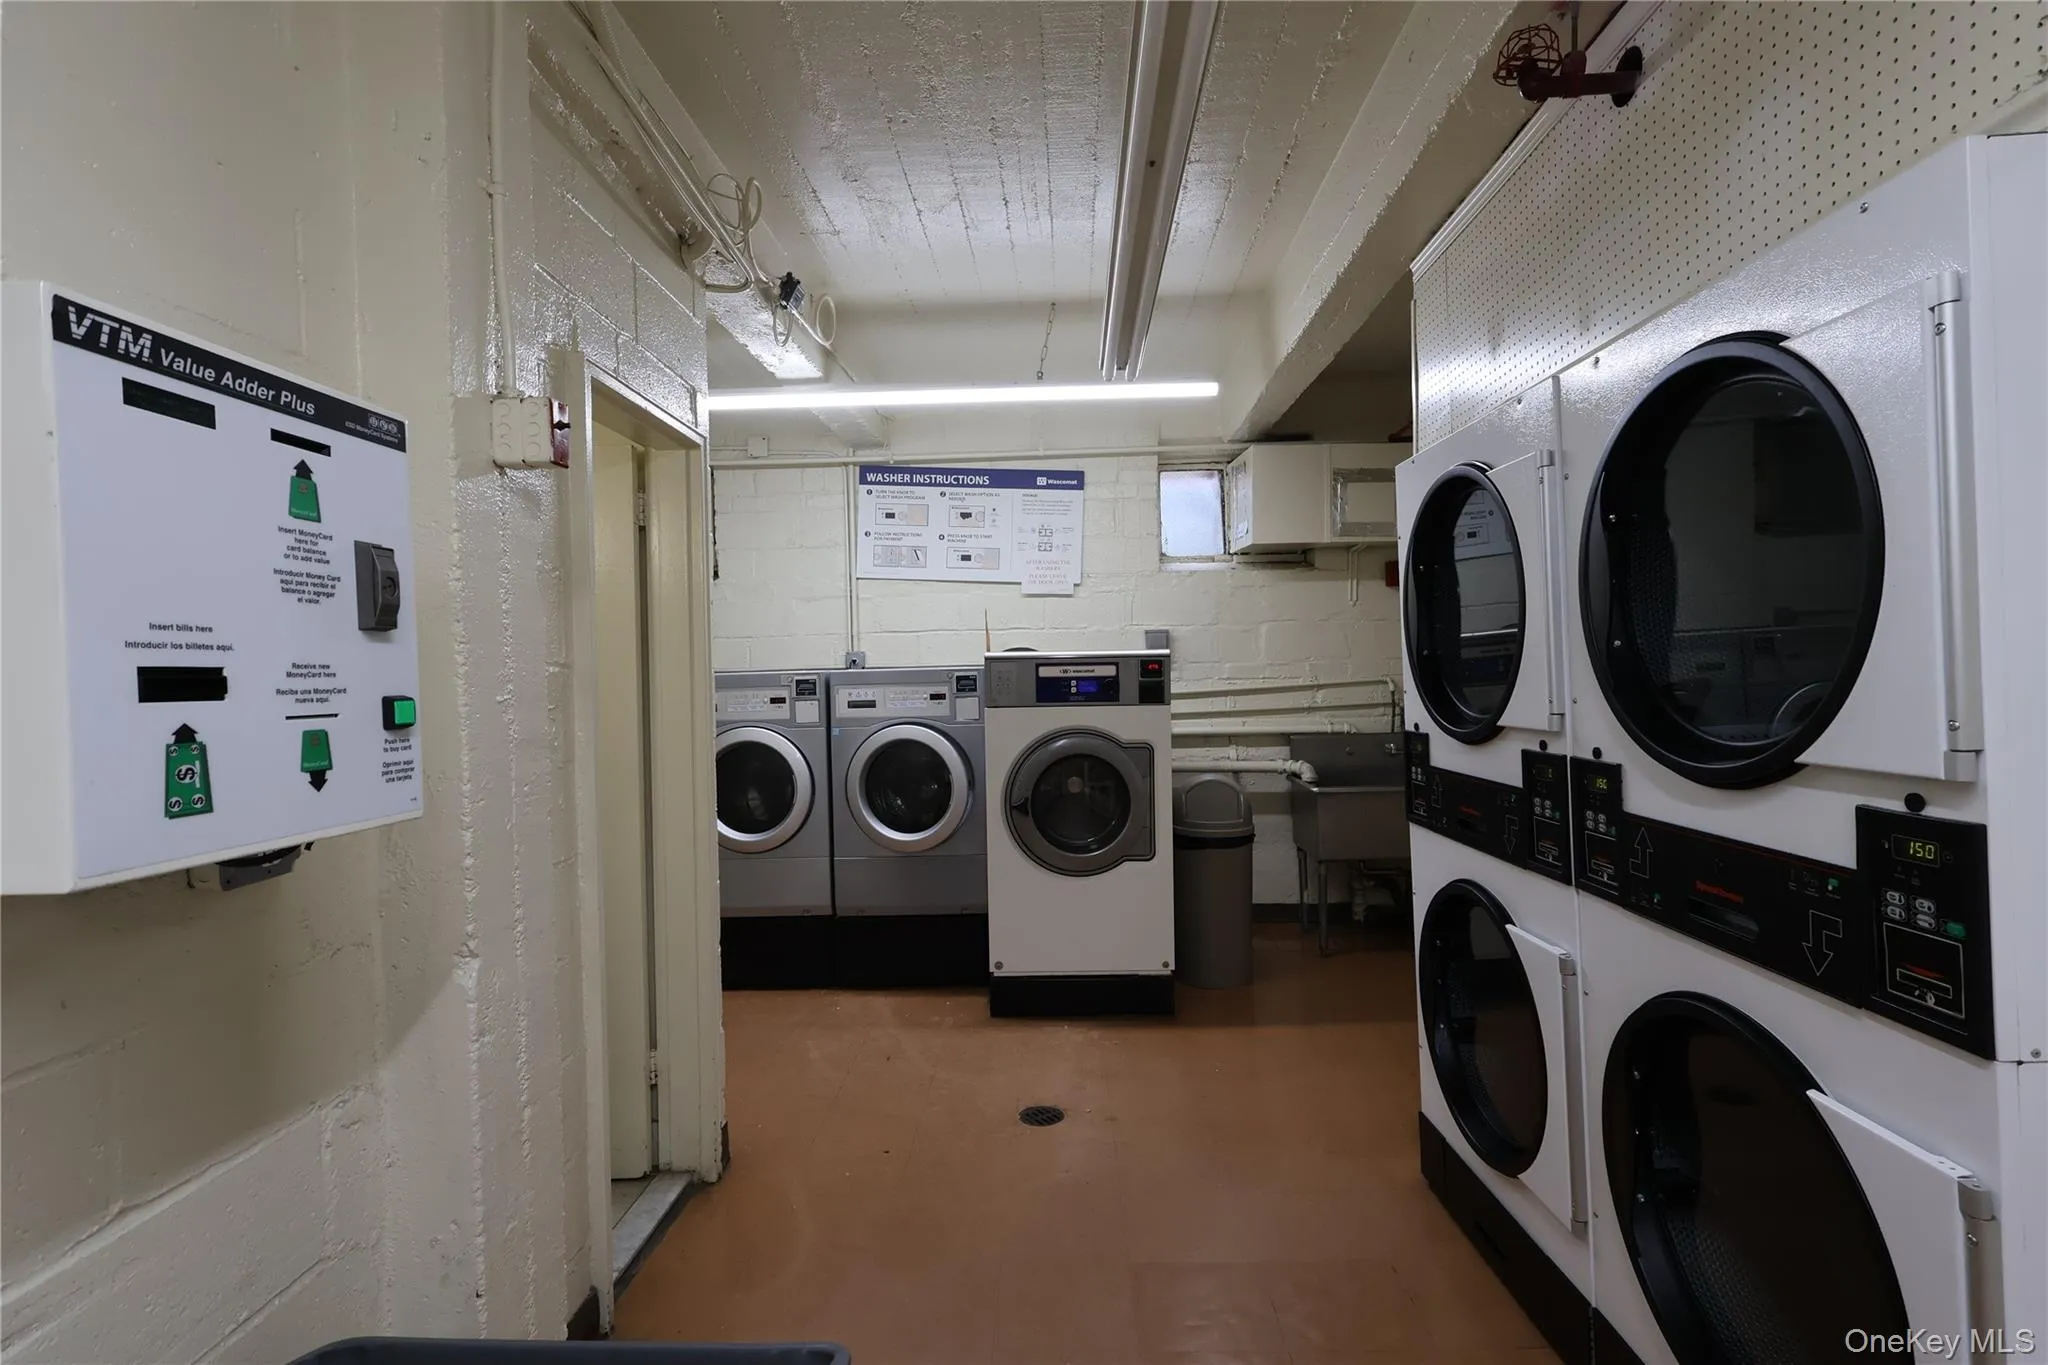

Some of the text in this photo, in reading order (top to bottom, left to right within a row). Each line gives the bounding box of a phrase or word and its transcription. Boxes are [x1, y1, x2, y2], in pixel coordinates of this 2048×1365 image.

[67, 305, 315, 415] VTM Value Adder Plus
[866, 473, 990, 484] WASHER INSTRUCTIONS
[278, 526, 333, 541] Insert MoneyCard
[294, 537, 308, 545] here
[286, 544, 326, 556] card balance
[300, 554, 312, 562] add
[314, 556, 330, 565] value
[273, 568, 341, 582] Introducir Money Card
[294, 580, 308, 588] para
[310, 579, 330, 589] recibir
[281, 586, 306, 595] balance
[312, 590, 336, 600] agregar
[149, 622, 214, 633] Insert bills here
[125, 640, 168, 650] Introducir
[171, 641, 184, 650] los
[186, 642, 214, 652] billetes
[313, 688, 346, 696] MoneyCard
[382, 761, 401, 769] Oprimir
[394, 766, 414, 775] comprar
[1909, 841, 1935, 860] 150
